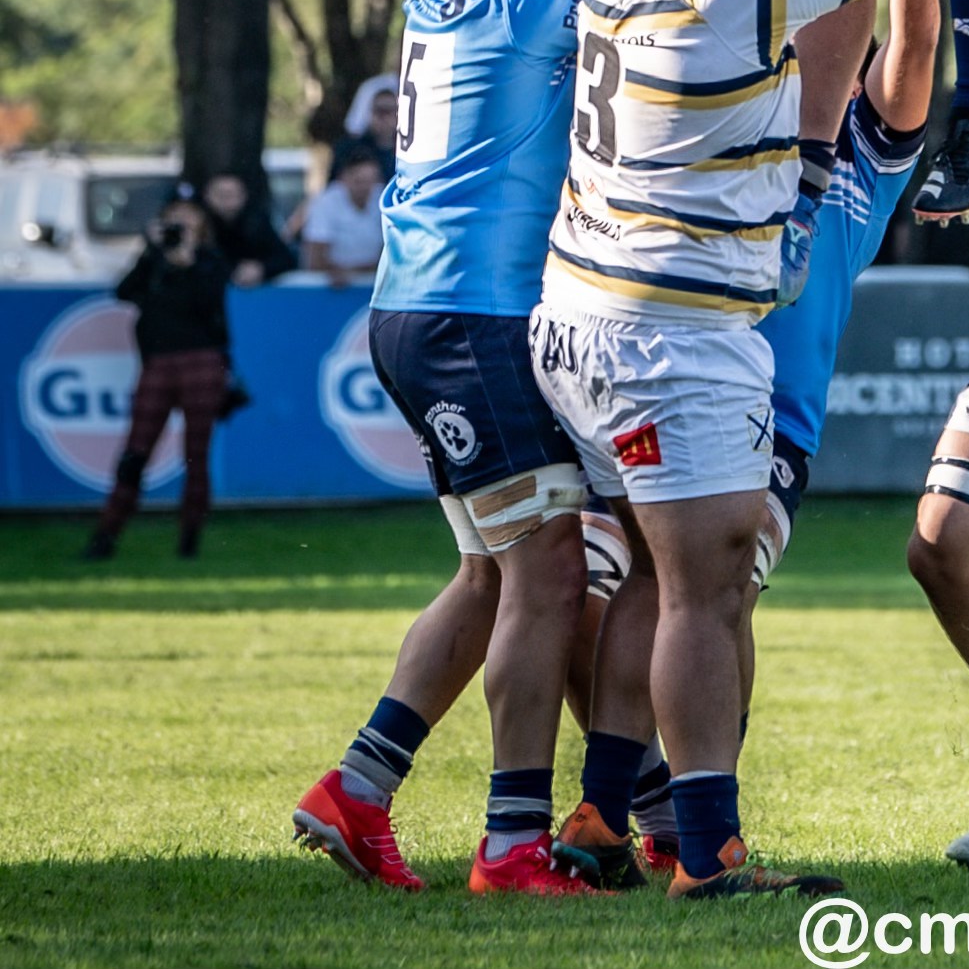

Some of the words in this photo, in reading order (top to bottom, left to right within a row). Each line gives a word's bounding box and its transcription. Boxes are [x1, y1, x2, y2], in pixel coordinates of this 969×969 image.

[398, 41, 428, 152] 5
[575, 31, 620, 168] 3
[39, 367, 136, 420] Gu
